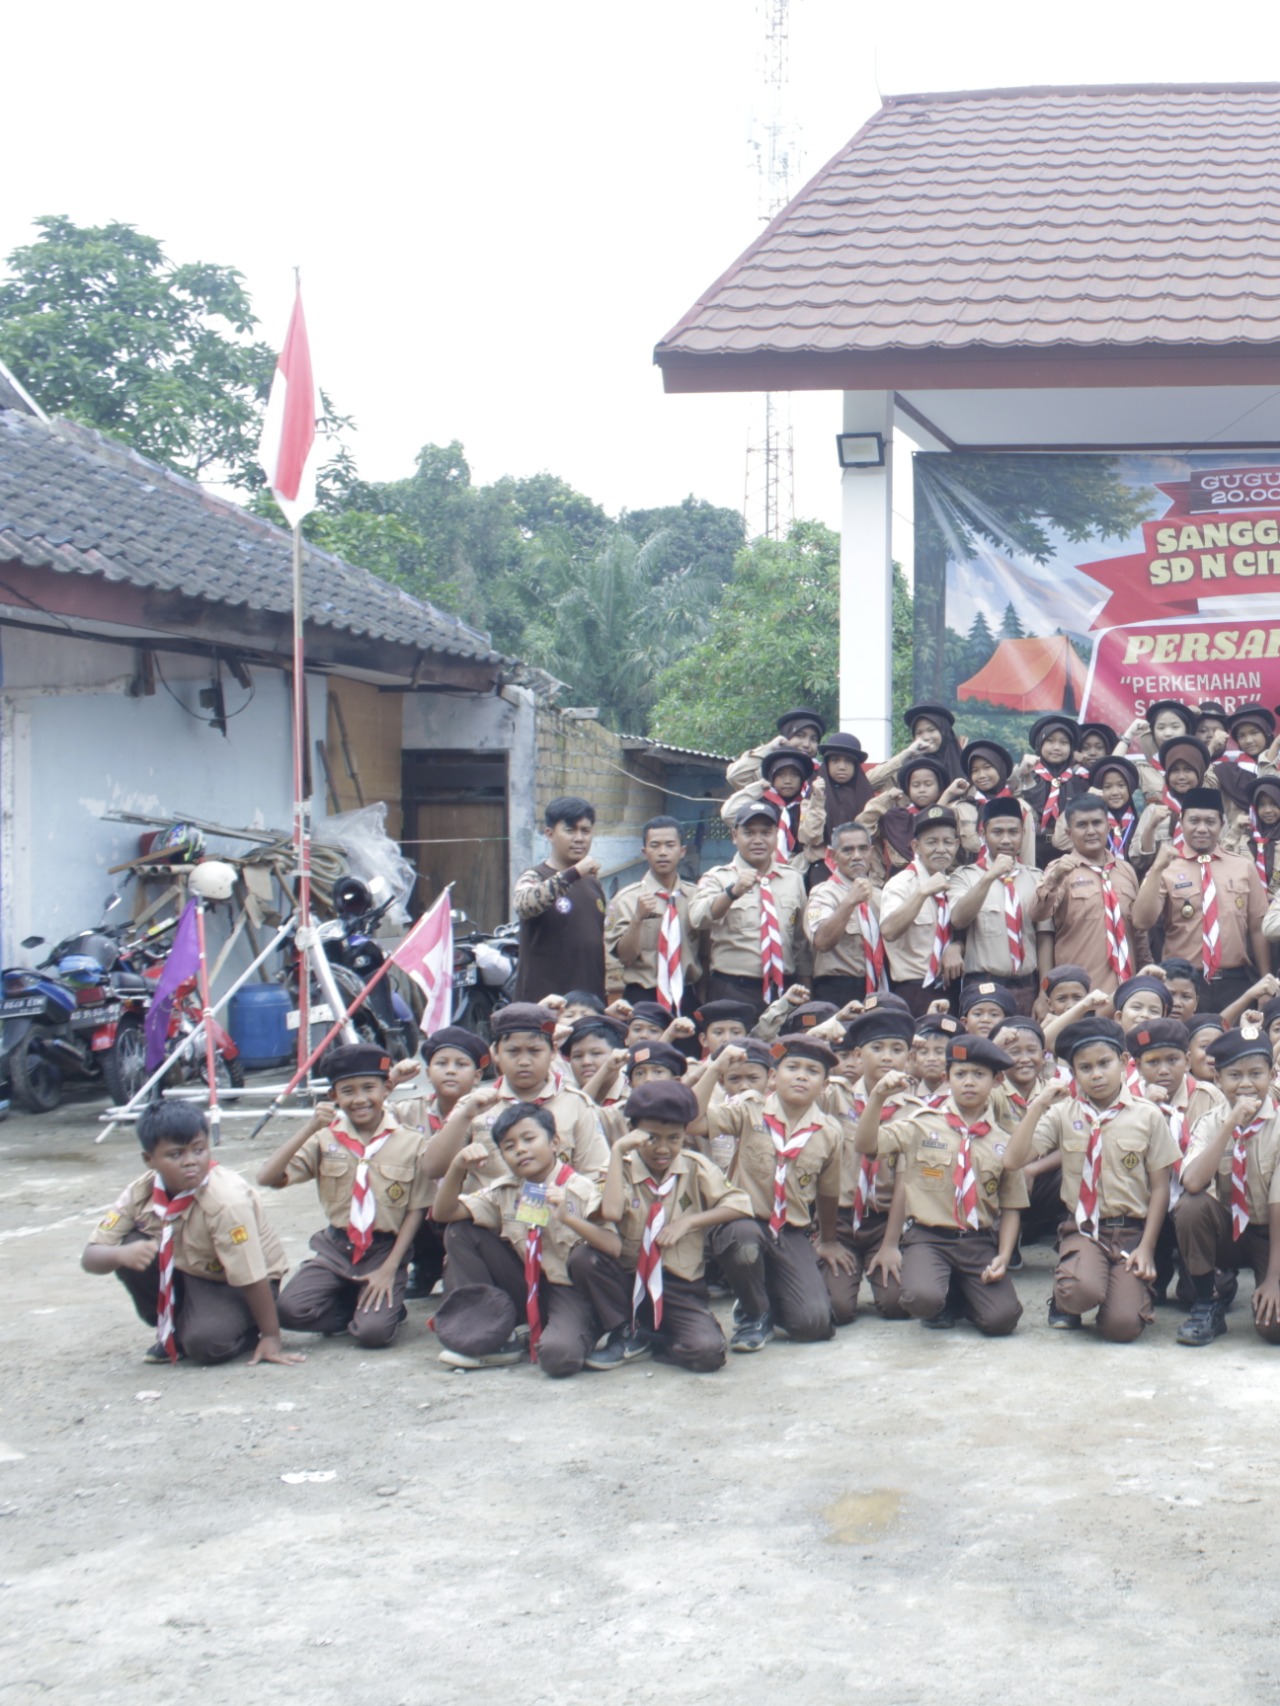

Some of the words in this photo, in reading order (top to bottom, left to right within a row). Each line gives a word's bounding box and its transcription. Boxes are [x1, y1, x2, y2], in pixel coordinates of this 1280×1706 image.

[1149, 557, 1195, 585] SD
[1200, 553, 1227, 579] N
[1120, 671, 1261, 694] "PERKEMAHAN
